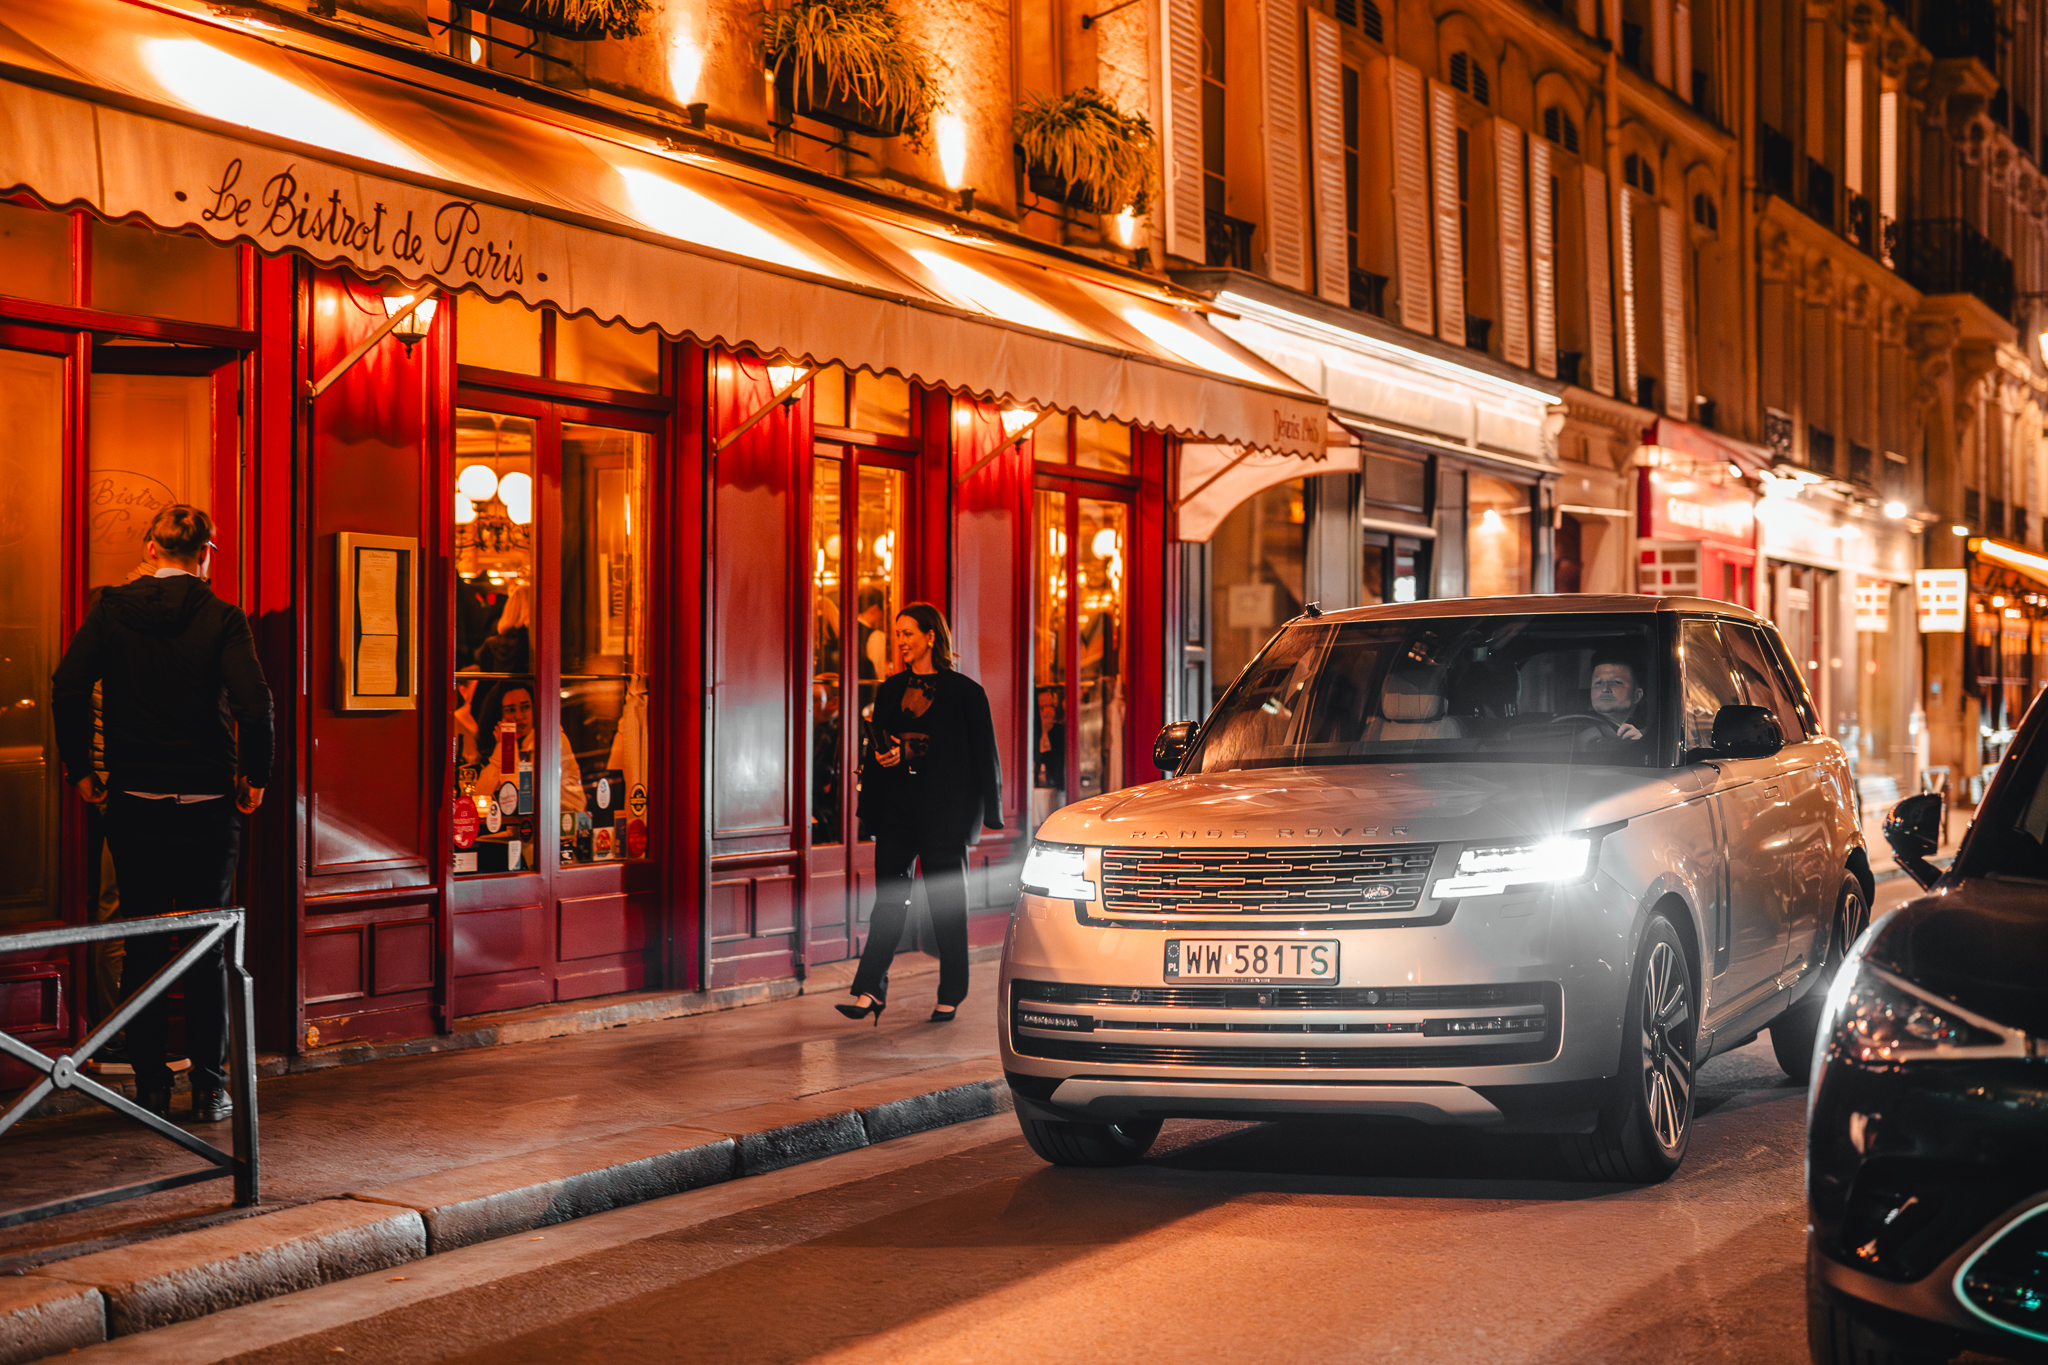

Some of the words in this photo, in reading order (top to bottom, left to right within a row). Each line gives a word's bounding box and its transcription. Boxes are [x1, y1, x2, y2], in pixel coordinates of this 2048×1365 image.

[202, 158, 251, 228] Le
[257, 163, 388, 255] Bistrot
[392, 210, 425, 266] de
[430, 201, 524, 286] Paris
[1273, 409, 1300, 442] Depuis
[1129, 828, 1249, 839] RANGE
[1275, 825, 1410, 839] ROVER
[1167, 963, 1179, 972] PL
[1186, 945, 1222, 974] WW
[1234, 945, 1329, 975] 581TS
